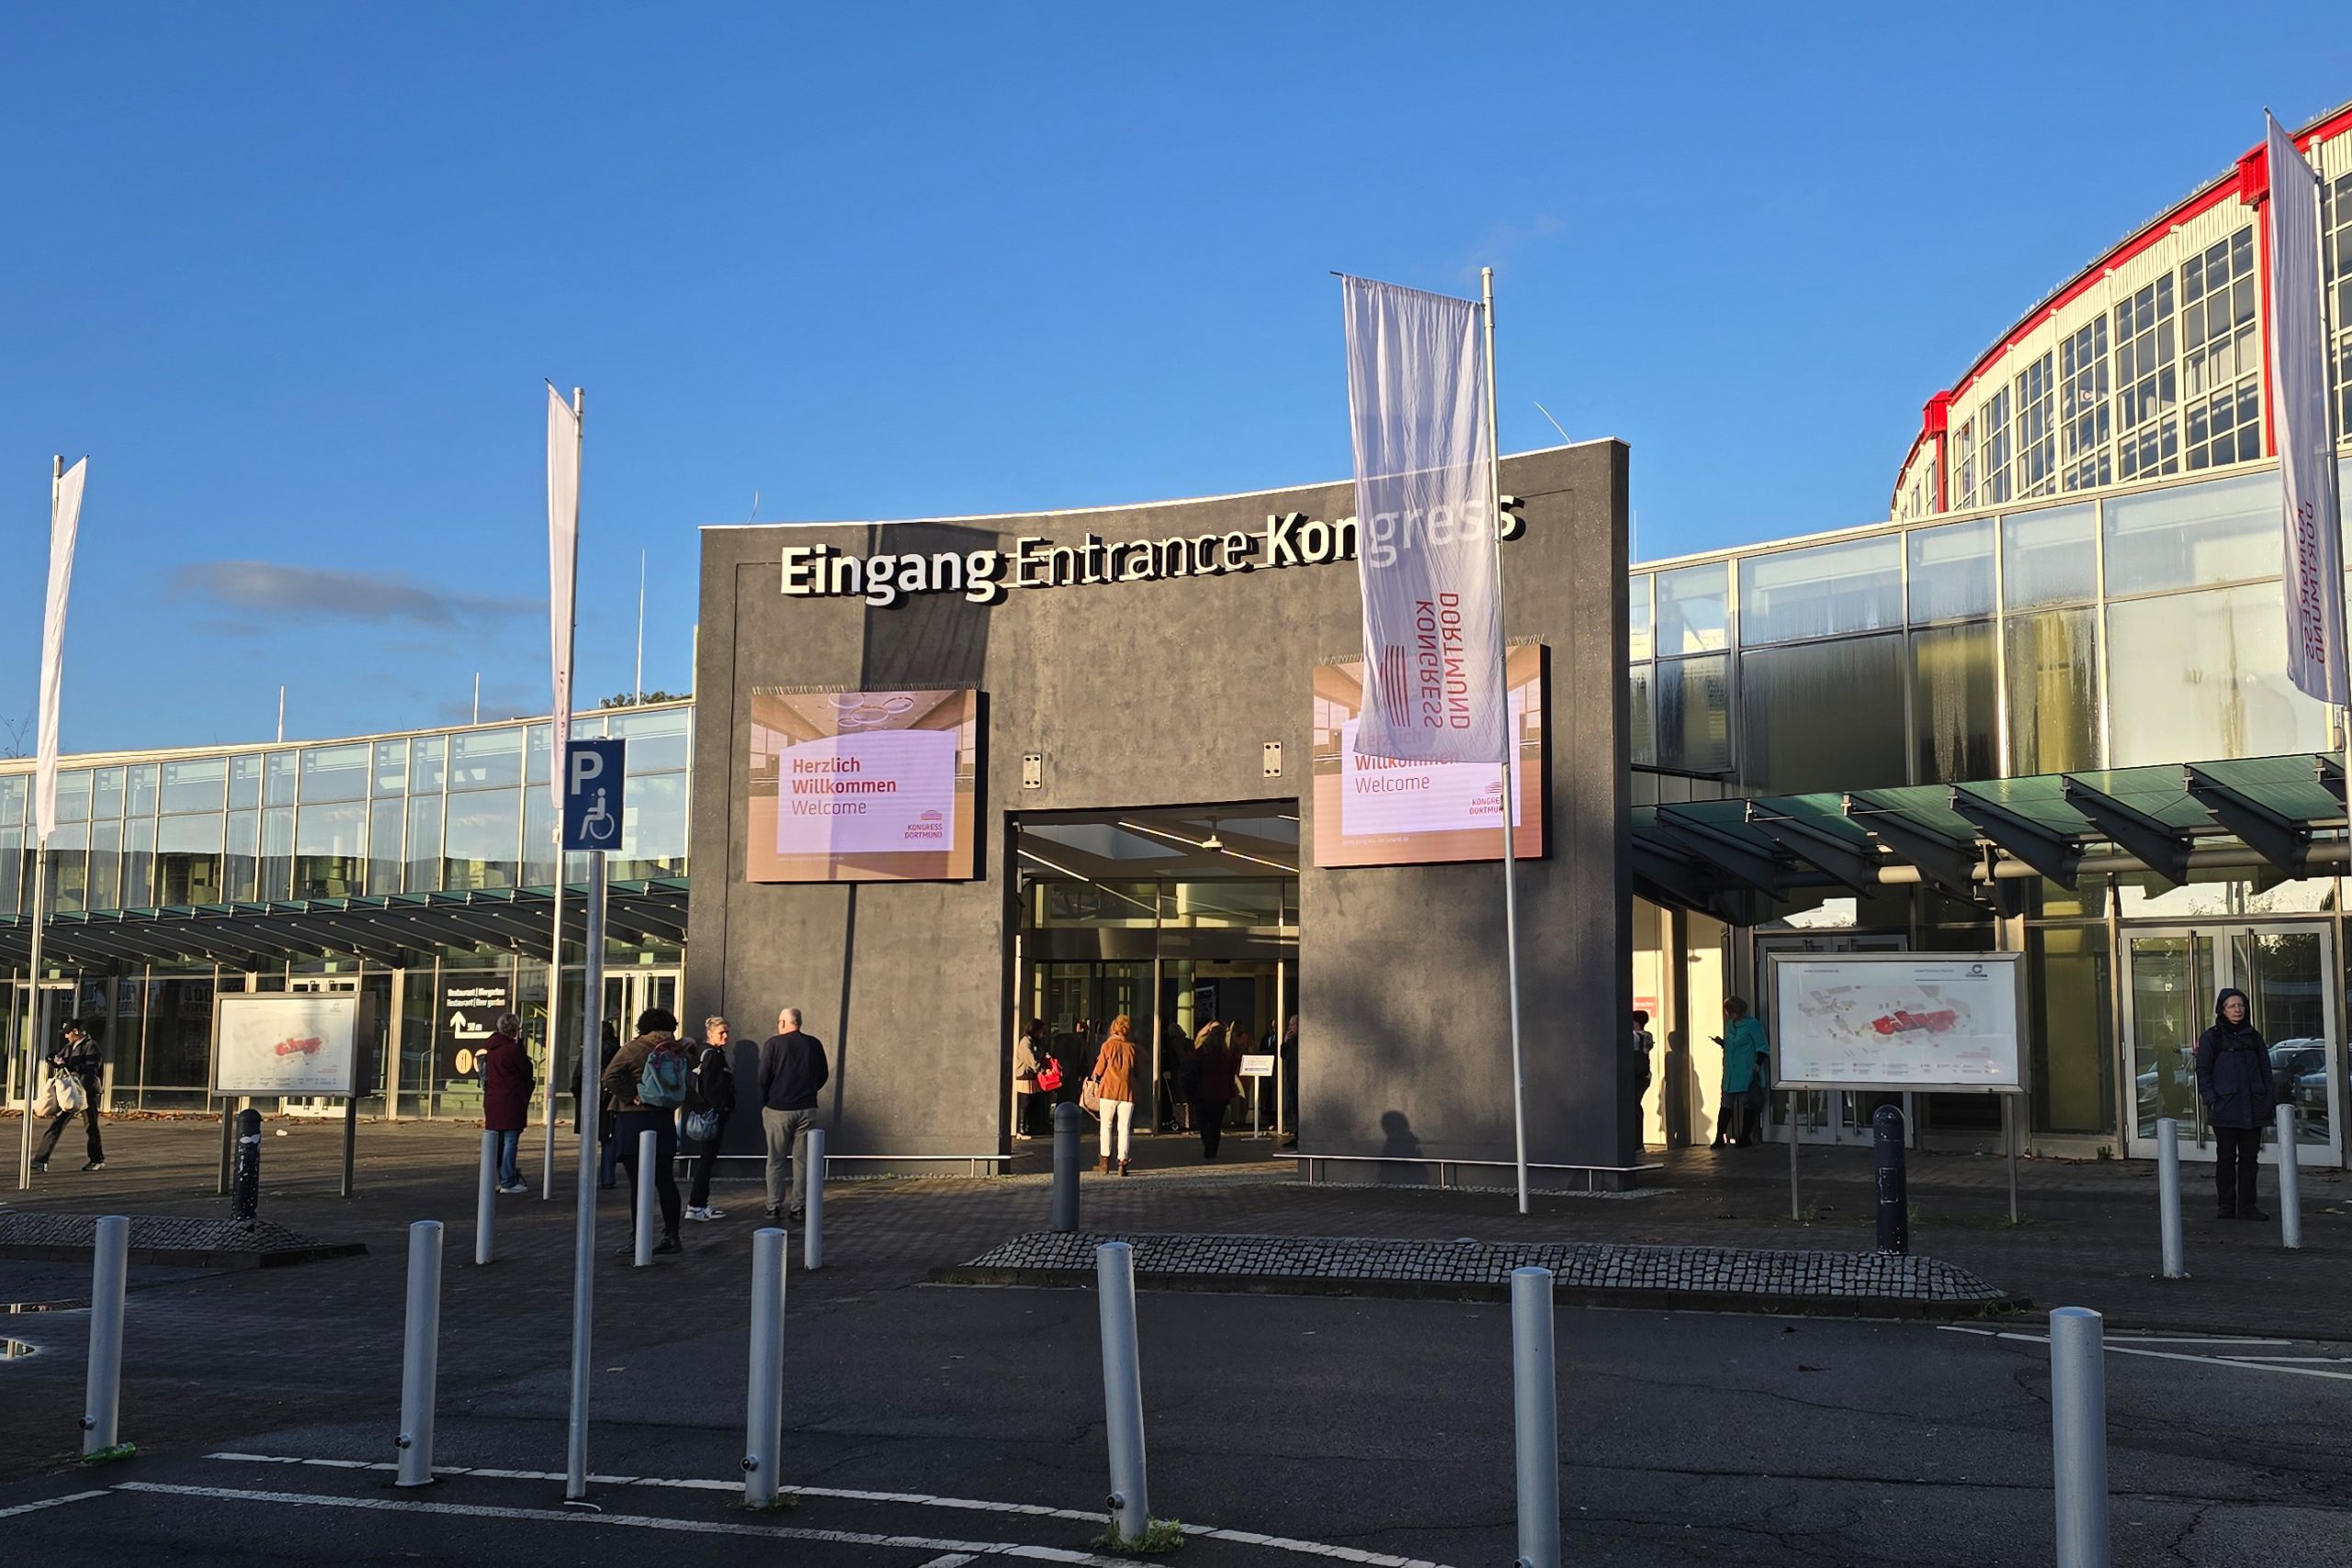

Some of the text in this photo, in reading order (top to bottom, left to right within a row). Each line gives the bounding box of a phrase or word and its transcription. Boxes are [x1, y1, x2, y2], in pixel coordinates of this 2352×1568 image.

[781, 495, 1517, 606] Eingang Entrance Kongress
[571, 750, 604, 795] P
[793, 757, 860, 773] Herzlich
[792, 779, 897, 795] Willkommen
[1355, 775, 1430, 794] Welcome
[792, 798, 866, 816] Welcome
[1472, 796, 1500, 806] KONGRE
[1469, 806, 1503, 815] DORTMU
[907, 823, 943, 831] KONGRESS
